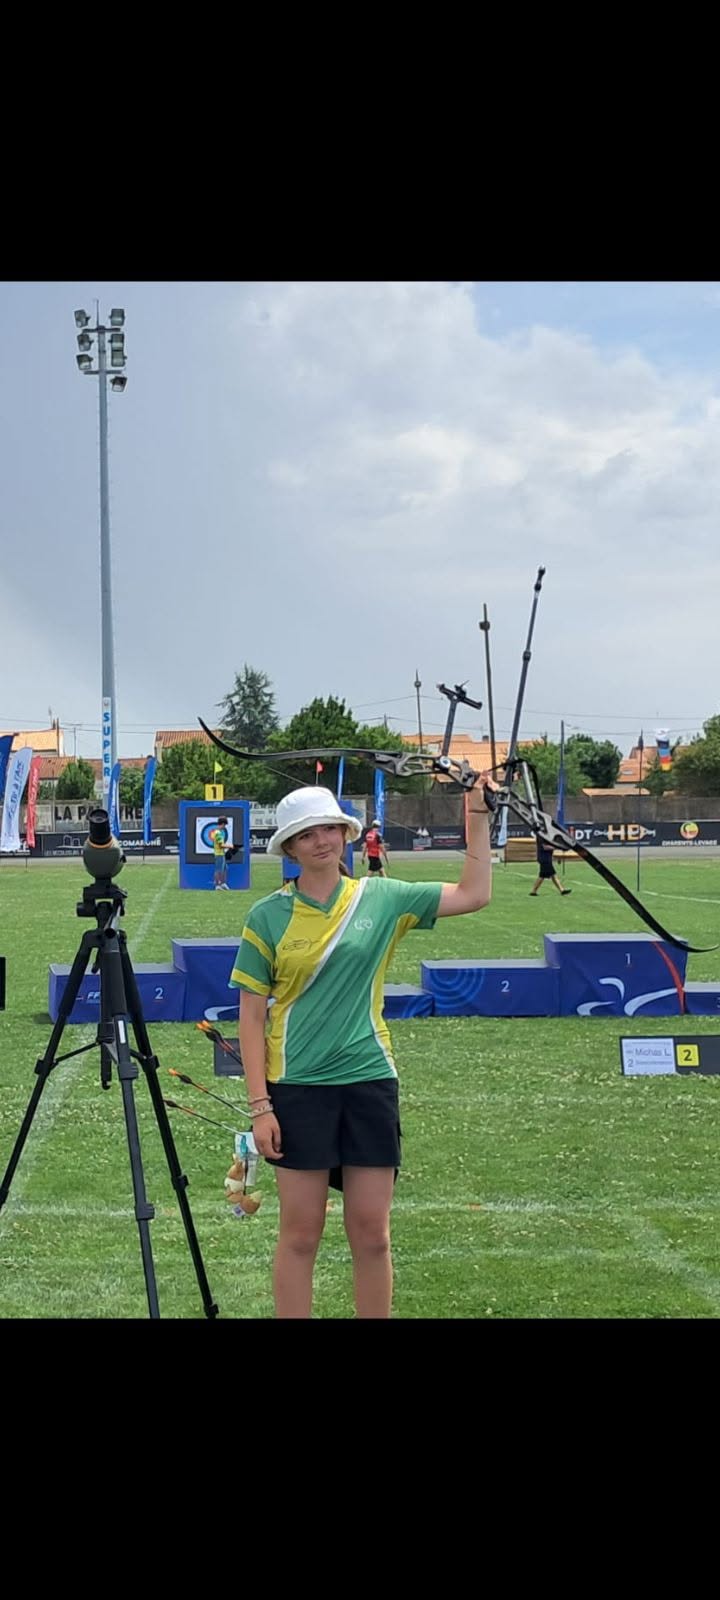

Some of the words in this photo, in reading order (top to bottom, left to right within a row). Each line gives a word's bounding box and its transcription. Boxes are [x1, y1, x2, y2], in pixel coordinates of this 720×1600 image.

[211, 786, 217, 799] 1
[54, 806, 73, 821] LA
[625, 953, 631, 965] 1
[500, 980, 510, 993] 2
[154, 987, 164, 1000] 2
[683, 1049, 692, 1062] 2
[627, 1058, 634, 1068] 2
